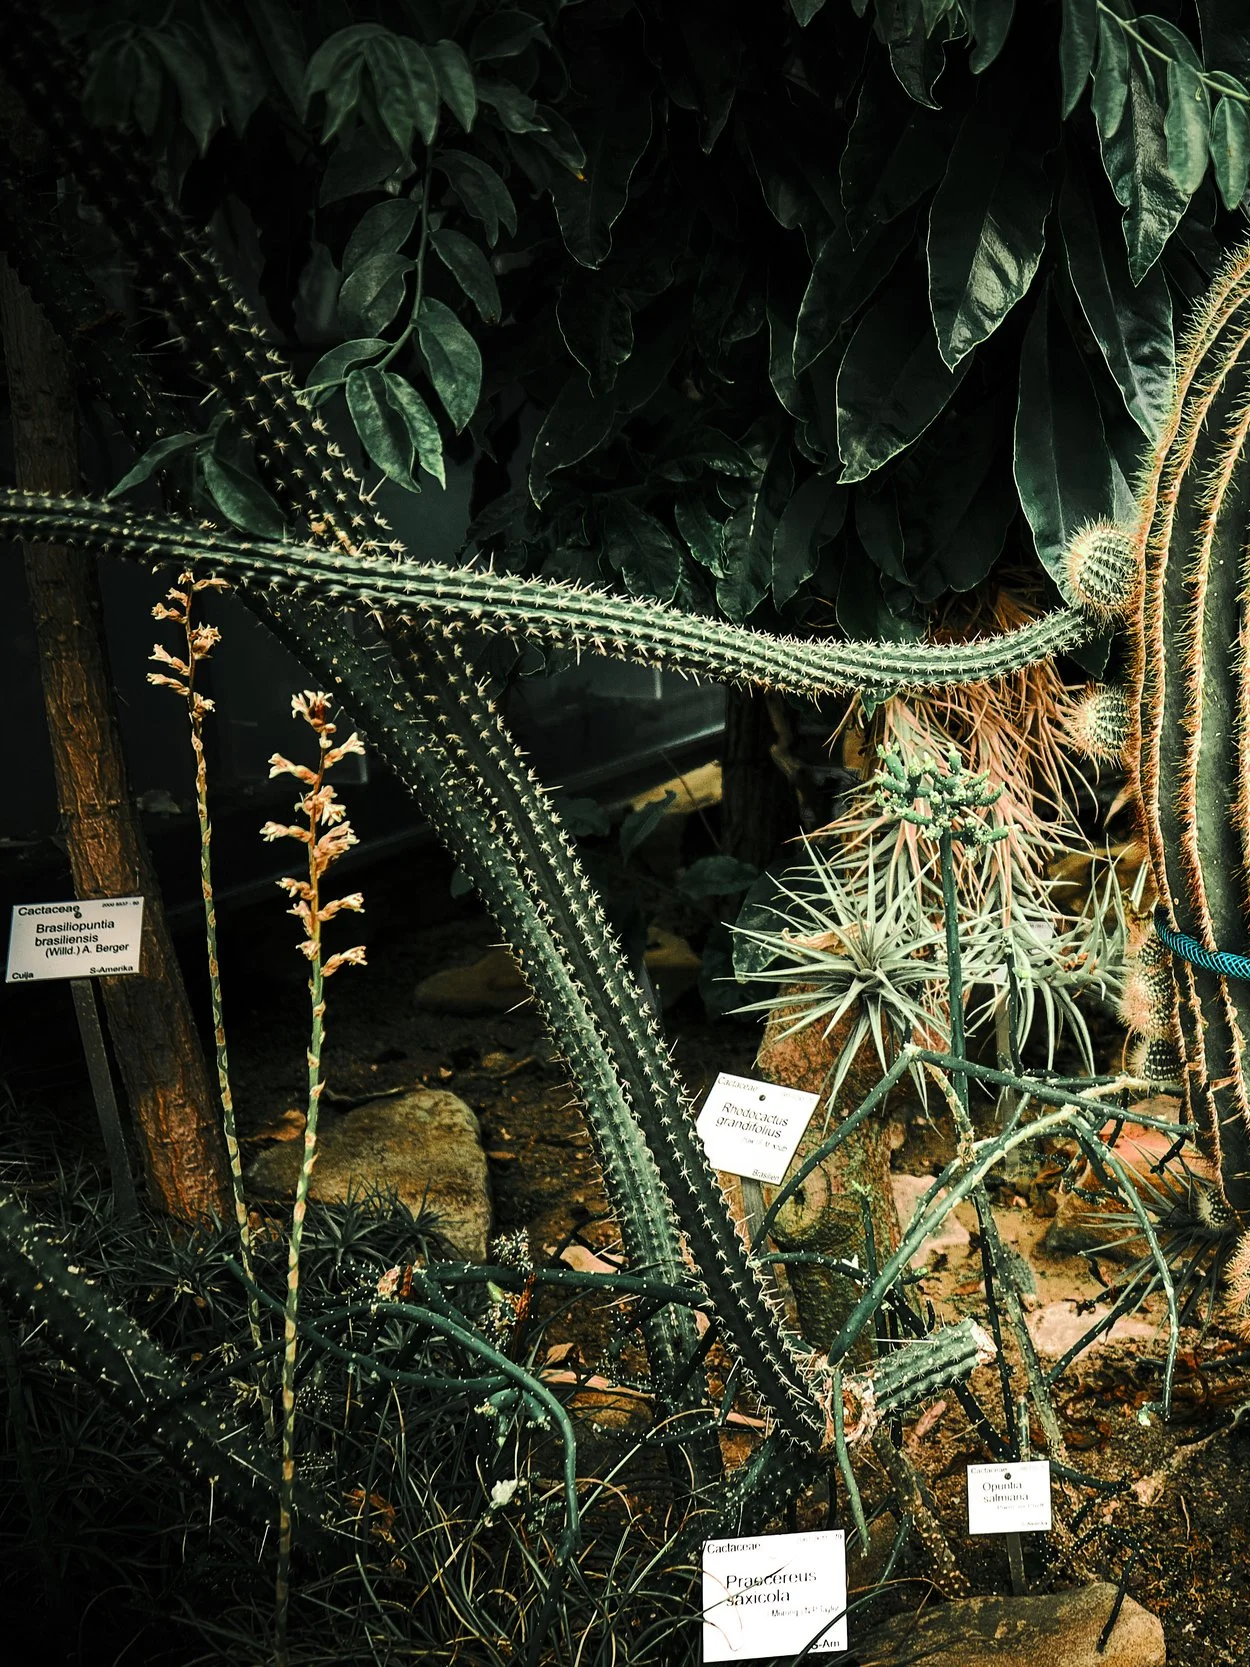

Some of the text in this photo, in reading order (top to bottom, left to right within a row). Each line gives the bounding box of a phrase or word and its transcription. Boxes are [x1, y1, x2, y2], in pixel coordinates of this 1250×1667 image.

[18, 905, 80, 916] Cactaceae
[36, 919, 115, 934] Brasiliopuntia
[35, 933, 99, 947] brasiliensis
[45, 943, 130, 959] (Willd.) A. Berger
[90, 964, 133, 974] S-Amerika
[721, 1102, 789, 1127] Rhodocactus
[715, 1116, 782, 1139] grandifolius
[707, 1543, 761, 1554] Cactaceae
[726, 1571, 817, 1589] Praecereus
[726, 1589, 790, 1606] saxicola
